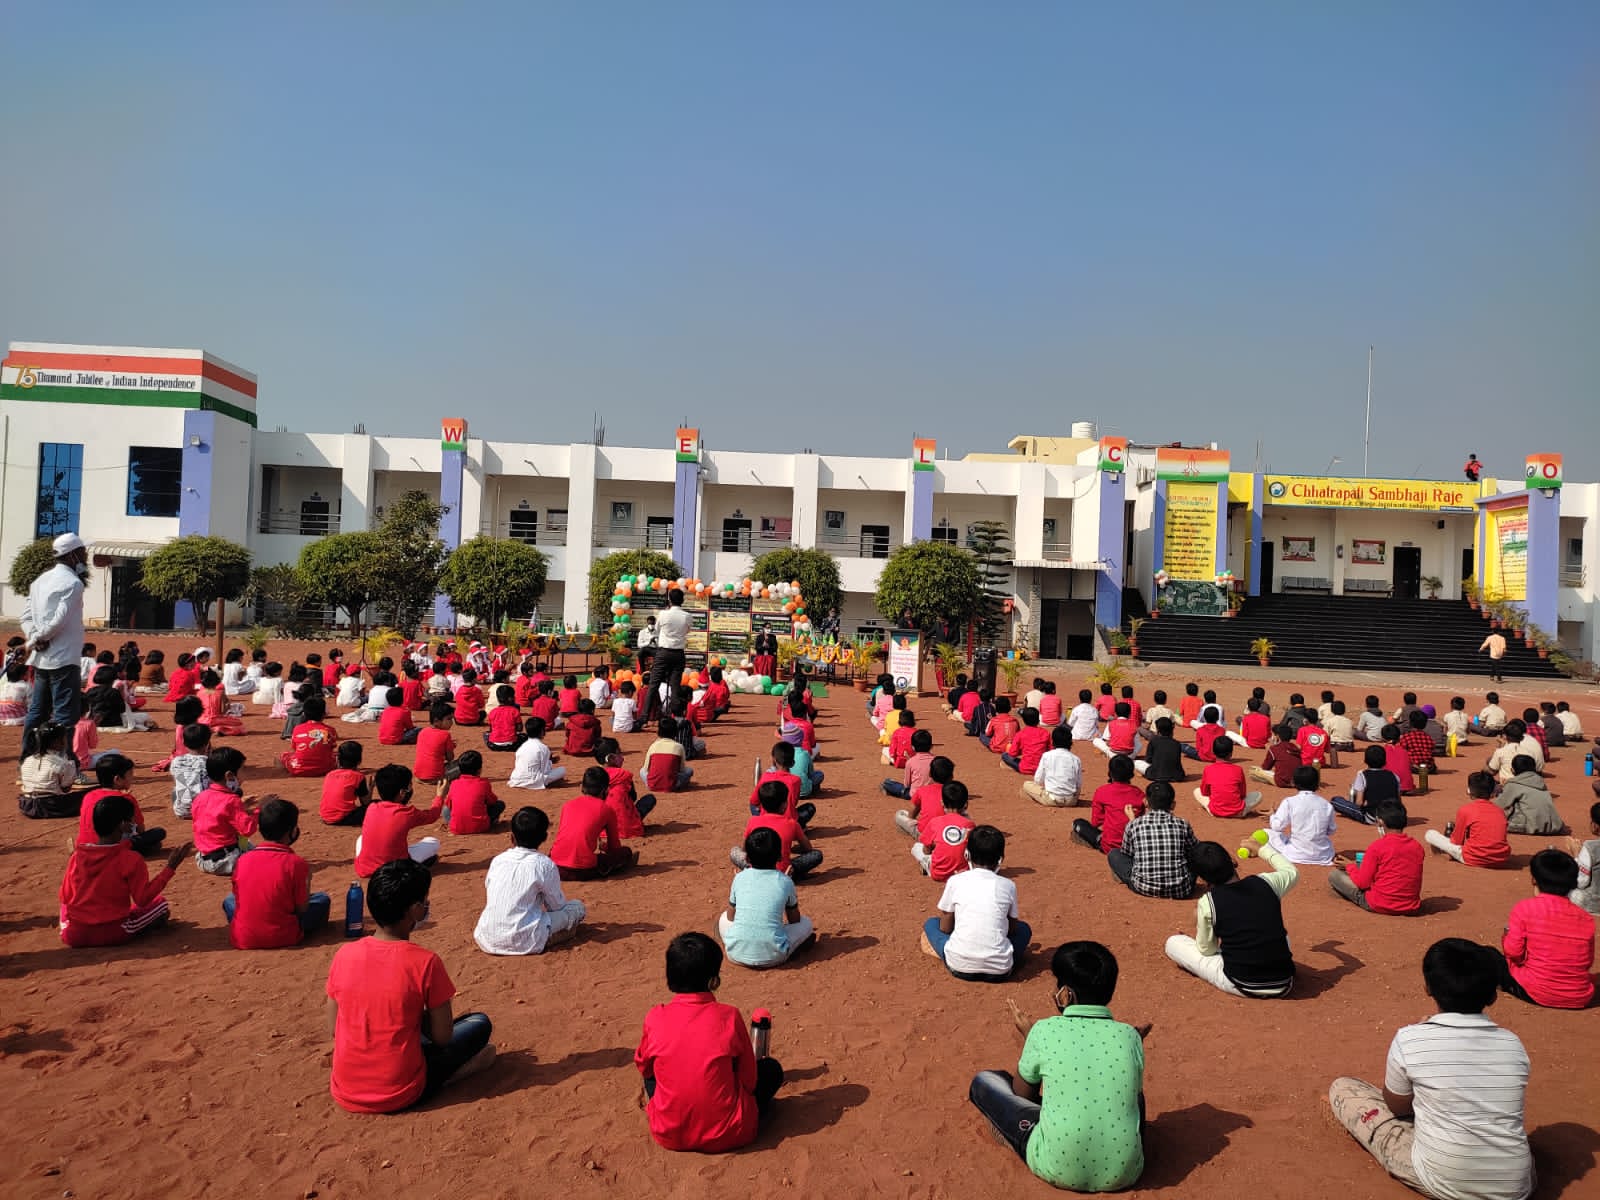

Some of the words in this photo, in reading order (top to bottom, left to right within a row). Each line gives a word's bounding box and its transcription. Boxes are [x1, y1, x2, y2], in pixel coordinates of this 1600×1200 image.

[10, 365, 41, 388] 75
[37, 371, 72, 384] Diamond
[76, 373, 104, 386] Jubilee
[112, 374, 137, 387] Indian
[140, 375, 196, 392] Independence
[444, 427, 462, 443] W
[680, 438, 692, 453] E
[919, 447, 930, 463] L
[1108, 446, 1121, 462] C
[1543, 463, 1557, 478] O
[1292, 484, 1364, 500] Chhatrapati
[1369, 486, 1427, 504] Sambhaji
[1432, 487, 1463, 505] Raje
